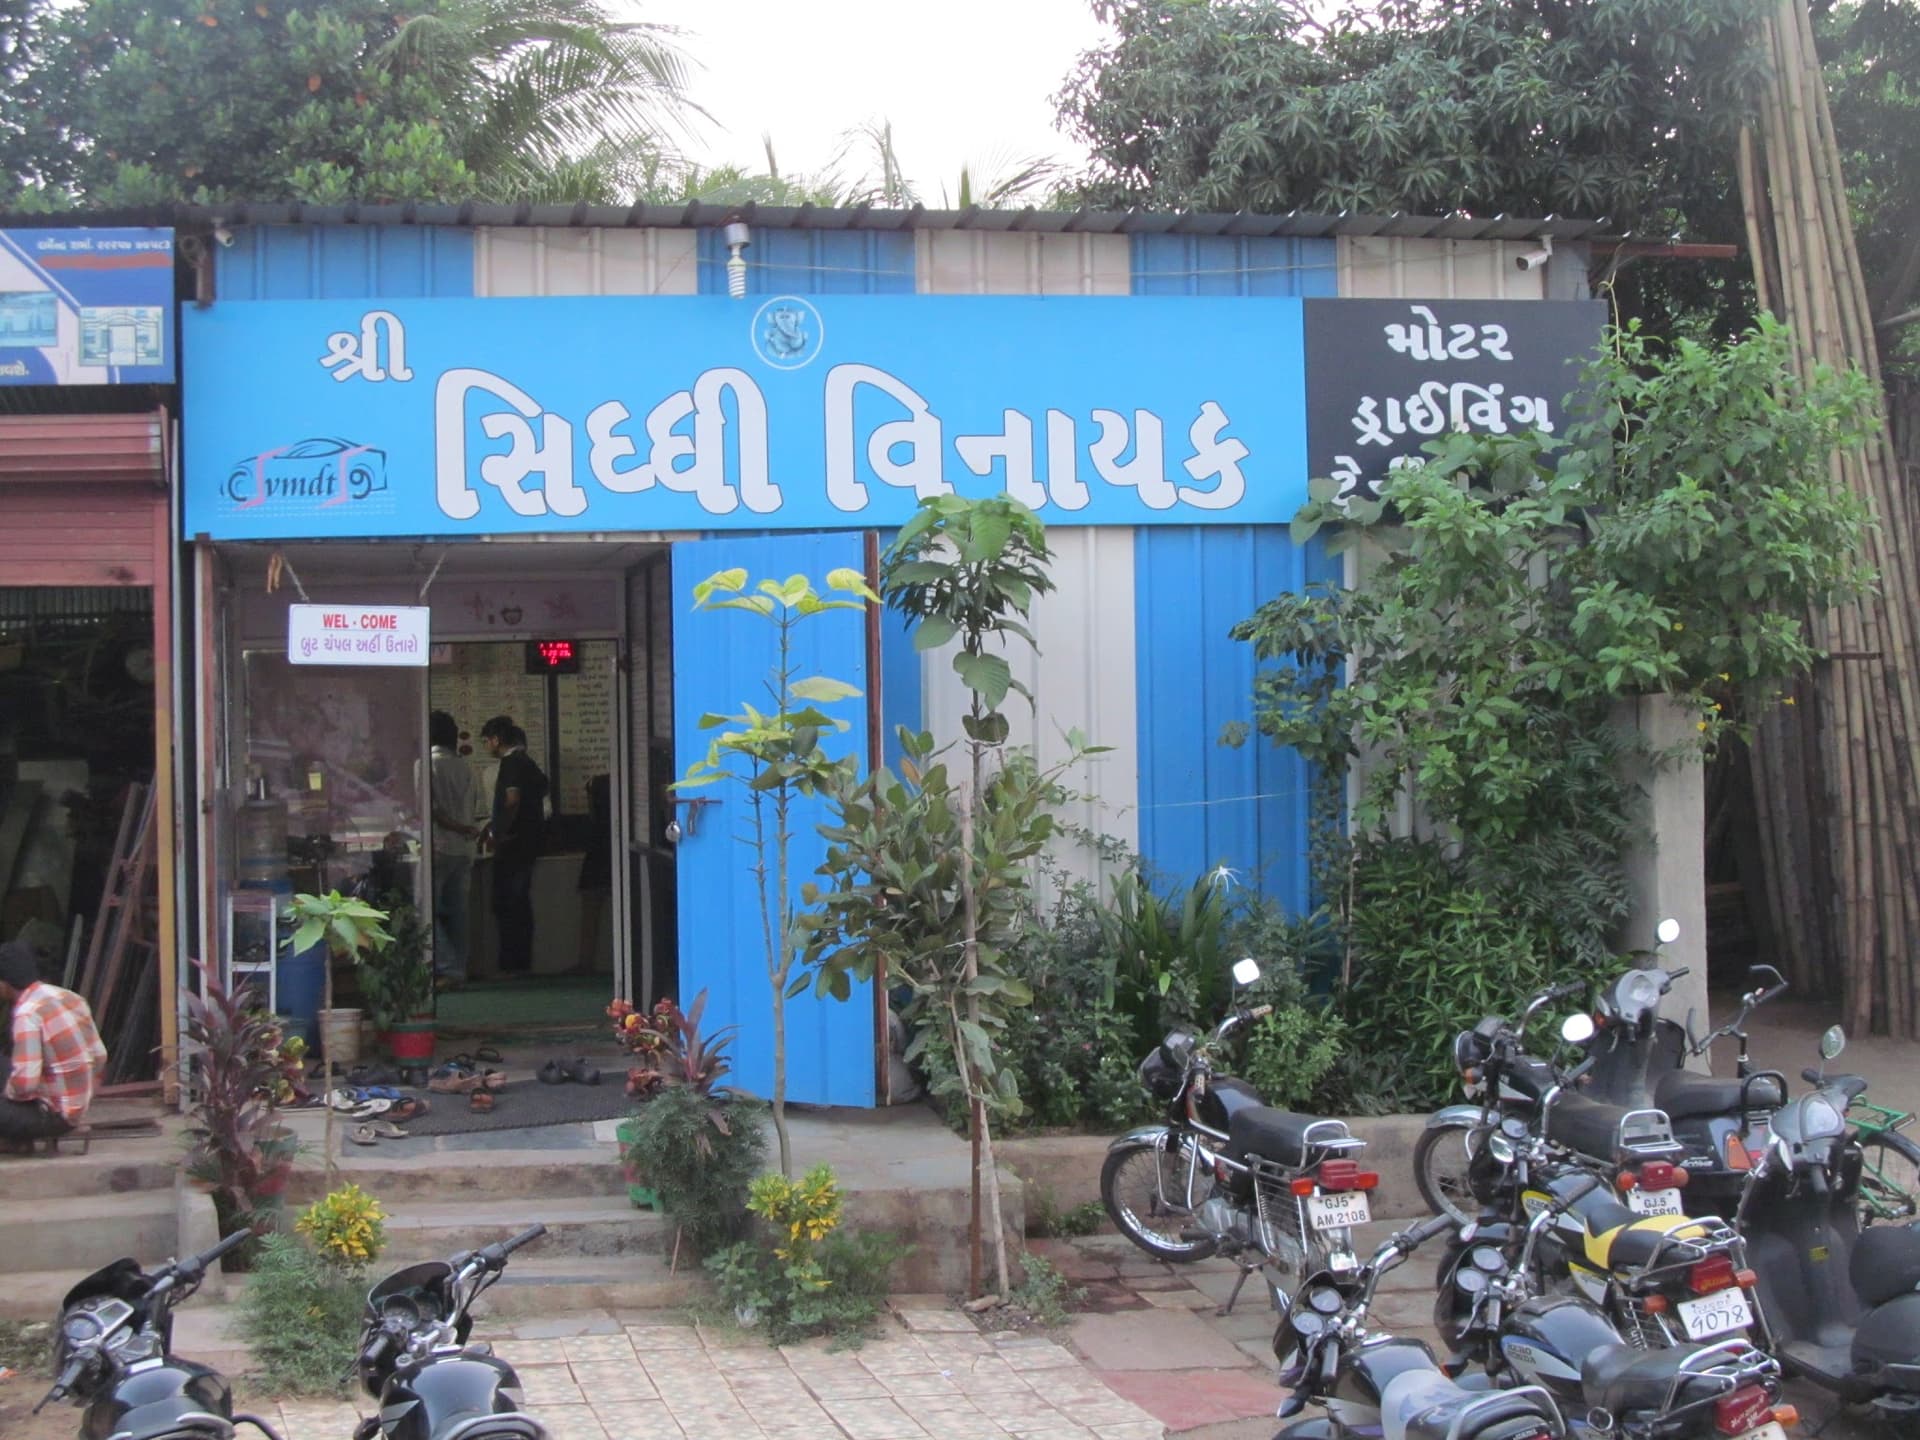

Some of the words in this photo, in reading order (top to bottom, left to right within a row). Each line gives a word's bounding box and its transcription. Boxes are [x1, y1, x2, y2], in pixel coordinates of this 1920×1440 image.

[320, 311, 414, 382] શ્રી
[1383, 305, 1514, 361] મોટર
[824, 363, 1250, 511] વિનાયક
[323, 634, 352, 653] ચંપલ
[385, 634, 418, 654] ઉતારો
[1325, 1196, 1349, 1209] GJ5
[1691, 1304, 1744, 1335] 9078
